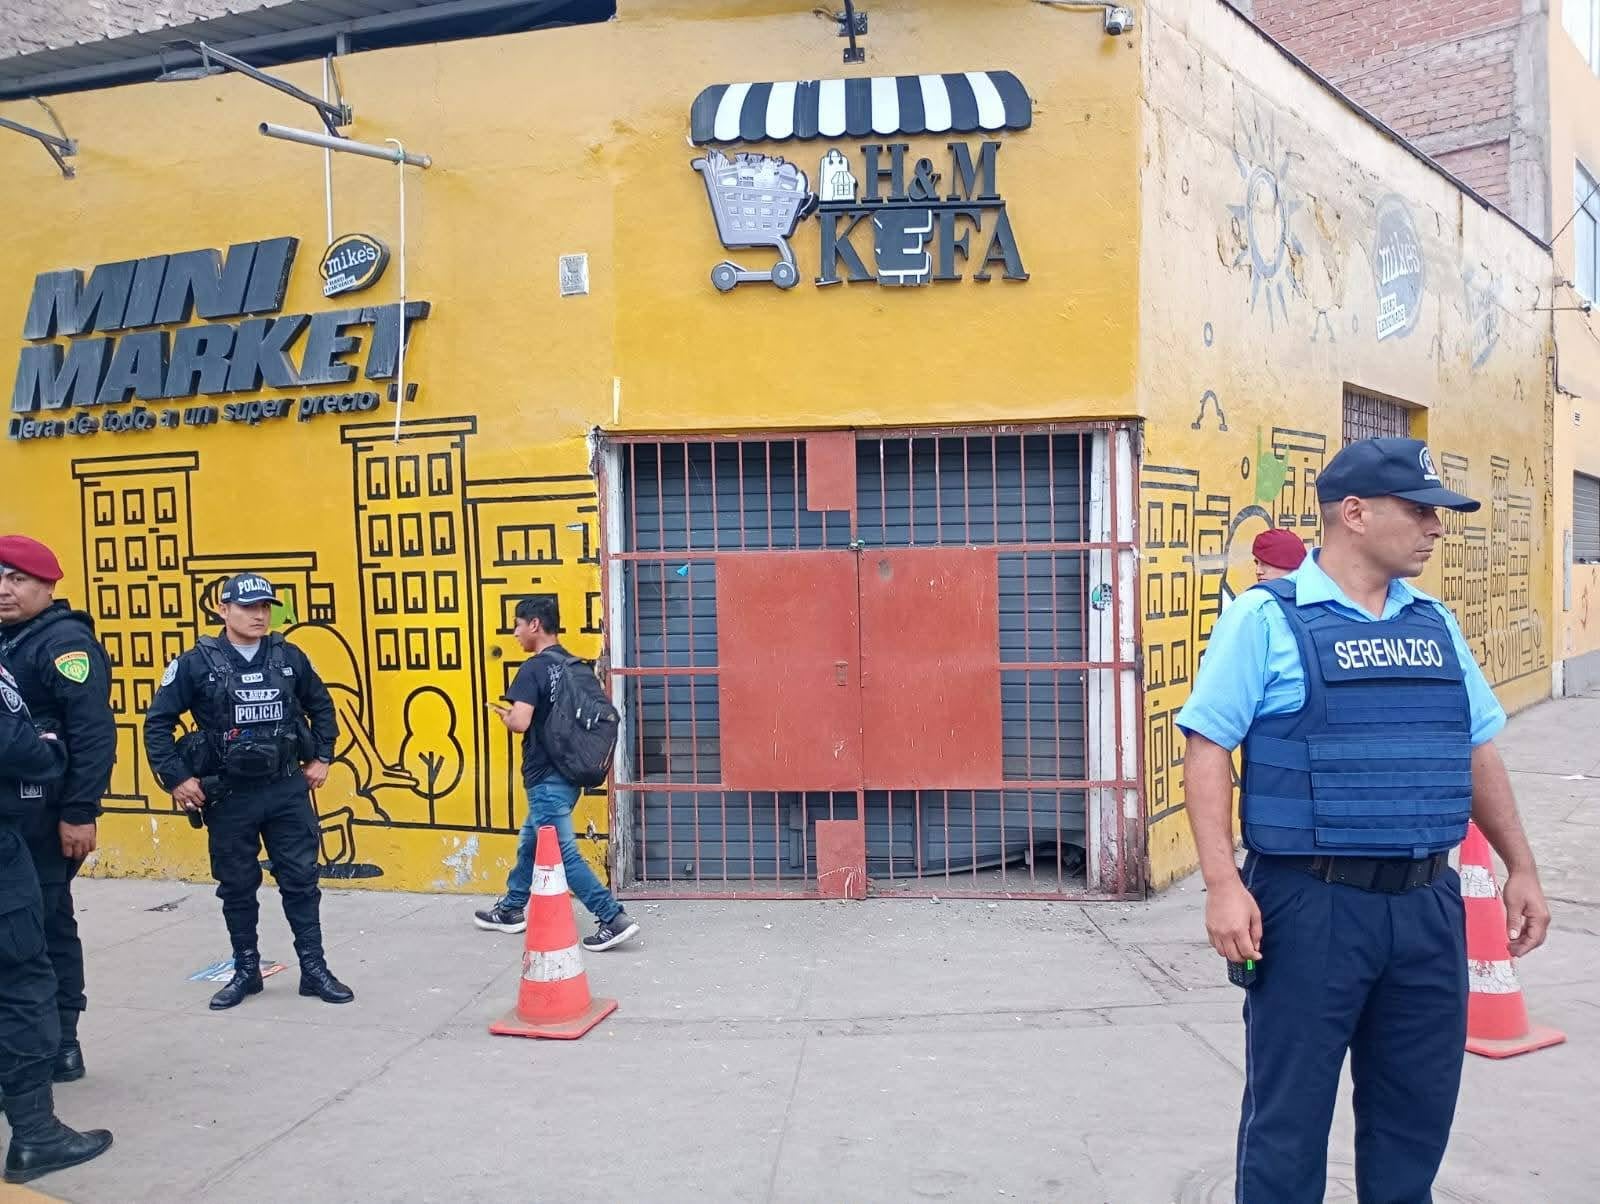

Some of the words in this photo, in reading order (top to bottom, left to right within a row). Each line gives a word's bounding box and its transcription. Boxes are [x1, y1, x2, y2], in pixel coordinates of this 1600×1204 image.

[860, 142, 1001, 201] H&M
[327, 245, 376, 276] mike's
[815, 208, 1031, 287] KEFA
[1379, 231, 1420, 285] mike's
[23, 236, 299, 341] MINI
[12, 301, 431, 413] MARKET
[66, 411, 100, 434] de
[102, 406, 157, 432] todo
[160, 408, 180, 429] a
[184, 406, 219, 425] un
[222, 399, 297, 425] super
[298, 391, 380, 422] precio
[1334, 637, 1444, 669] SERENAZGO
[238, 703, 282, 721] POLICIA
